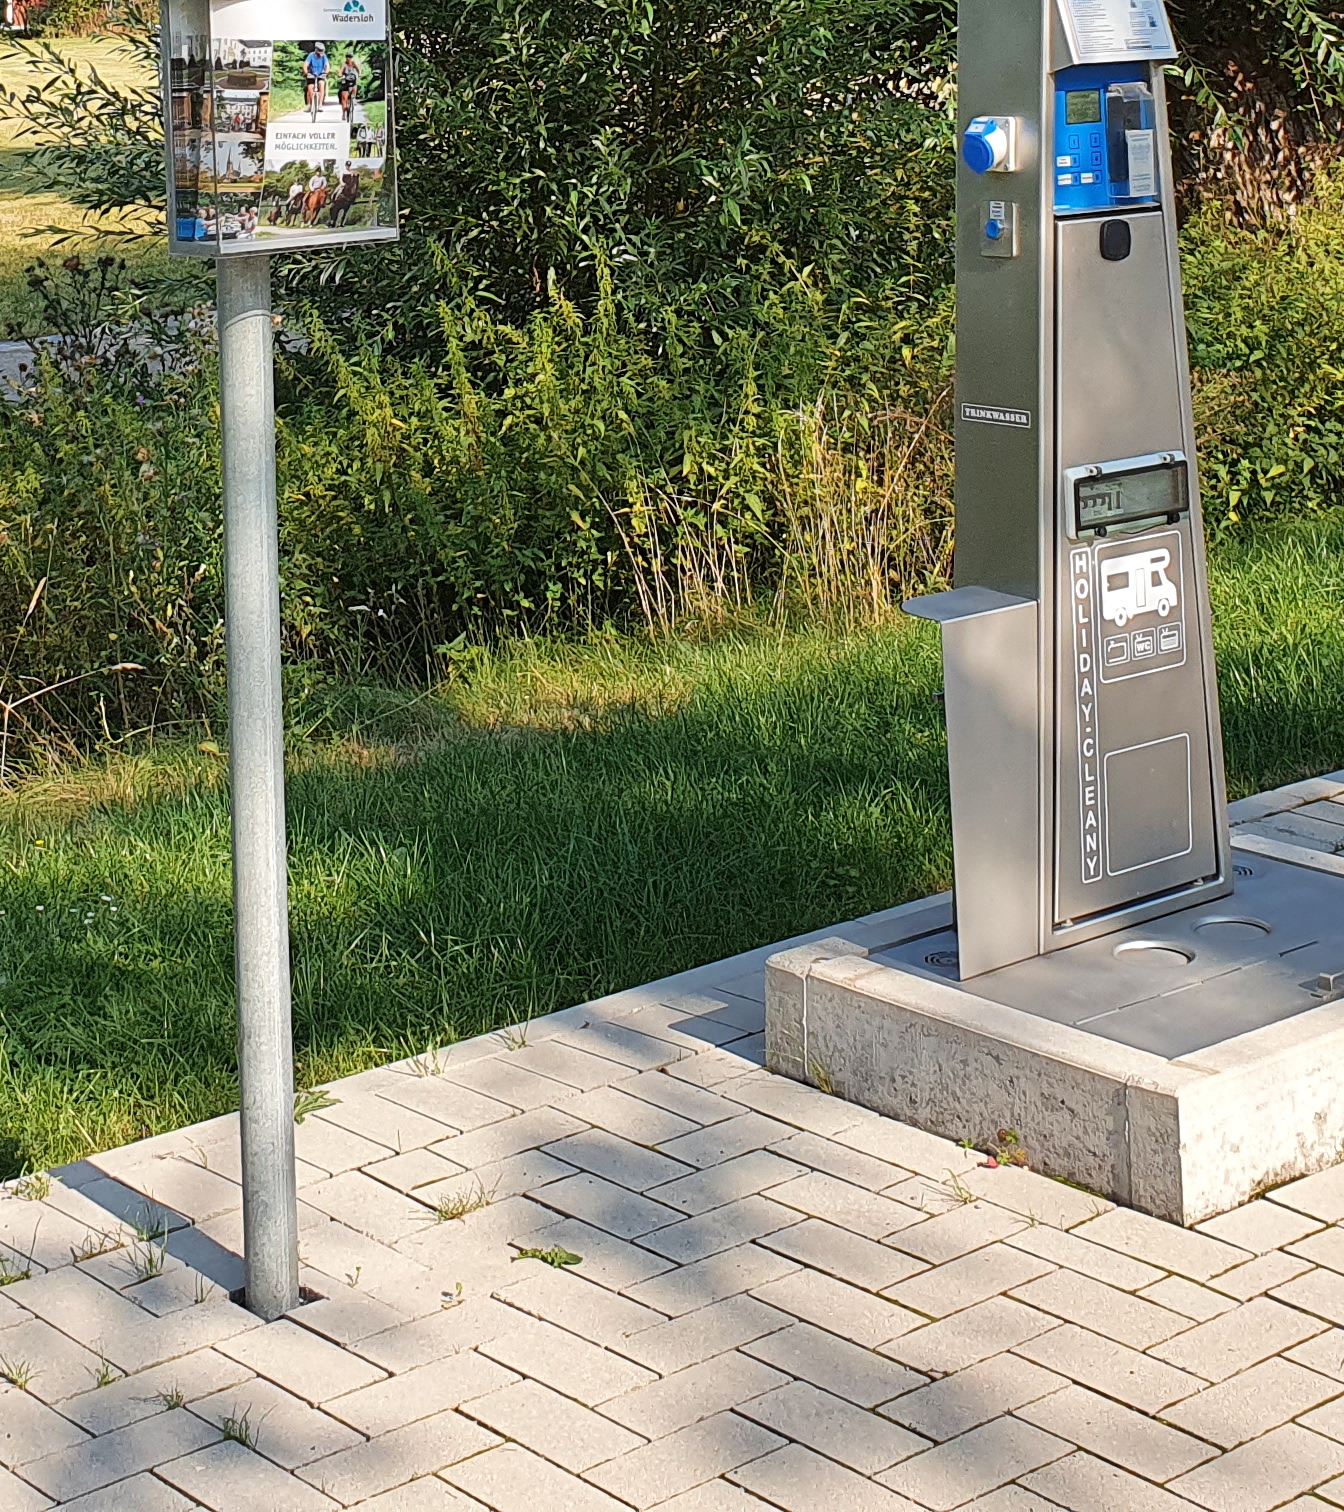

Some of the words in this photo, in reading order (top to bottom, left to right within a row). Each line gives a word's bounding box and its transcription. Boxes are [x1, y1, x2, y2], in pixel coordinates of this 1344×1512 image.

[331, 13, 374, 23] Wadersloh
[275, 132, 307, 140] EINFACH
[308, 132, 336, 140] VOLLER
[964, 407, 1029, 424] TRINKWASSER
[1135, 640, 1152, 653] WC
